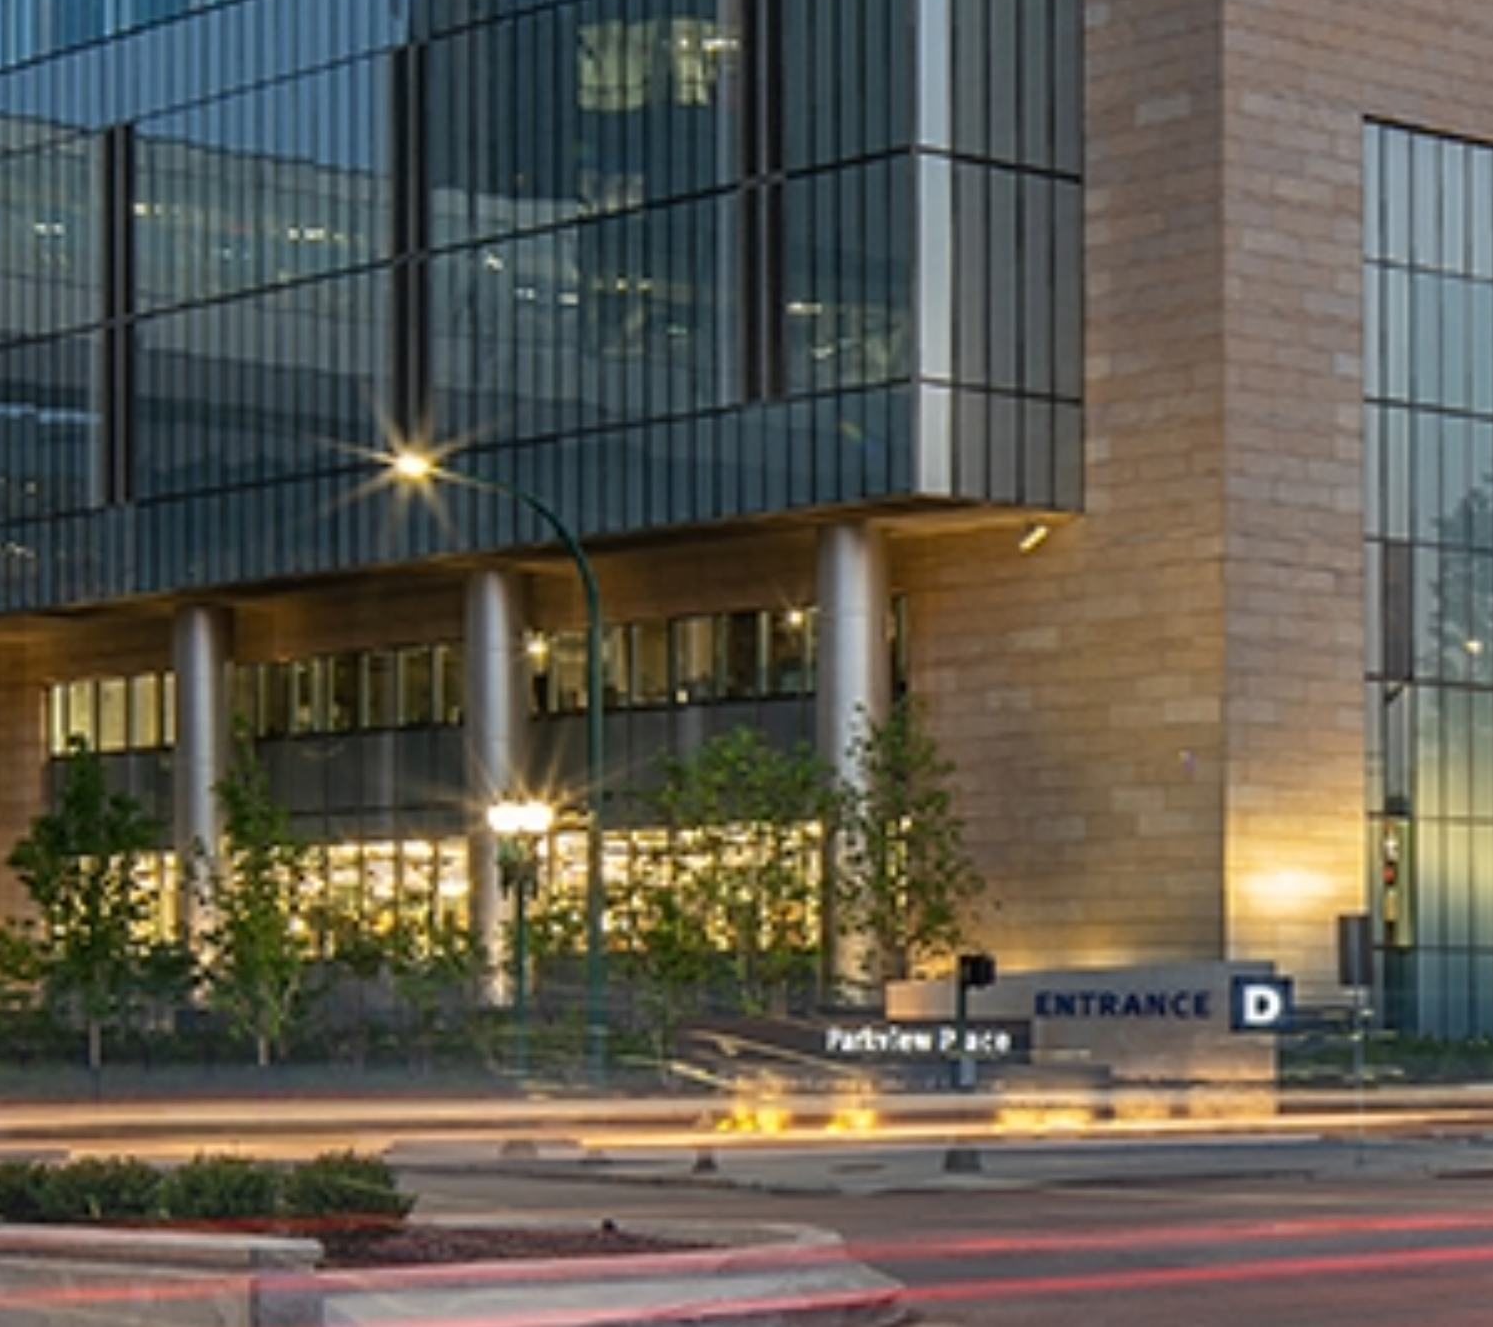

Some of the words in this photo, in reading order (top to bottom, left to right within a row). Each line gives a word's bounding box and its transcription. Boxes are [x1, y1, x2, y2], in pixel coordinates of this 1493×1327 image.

[1034, 990, 1212, 1018] ENTRANCE
[1242, 984, 1281, 1026] D
[824, 1024, 932, 1053] Parkview
[938, 1024, 1012, 1053] Pace
